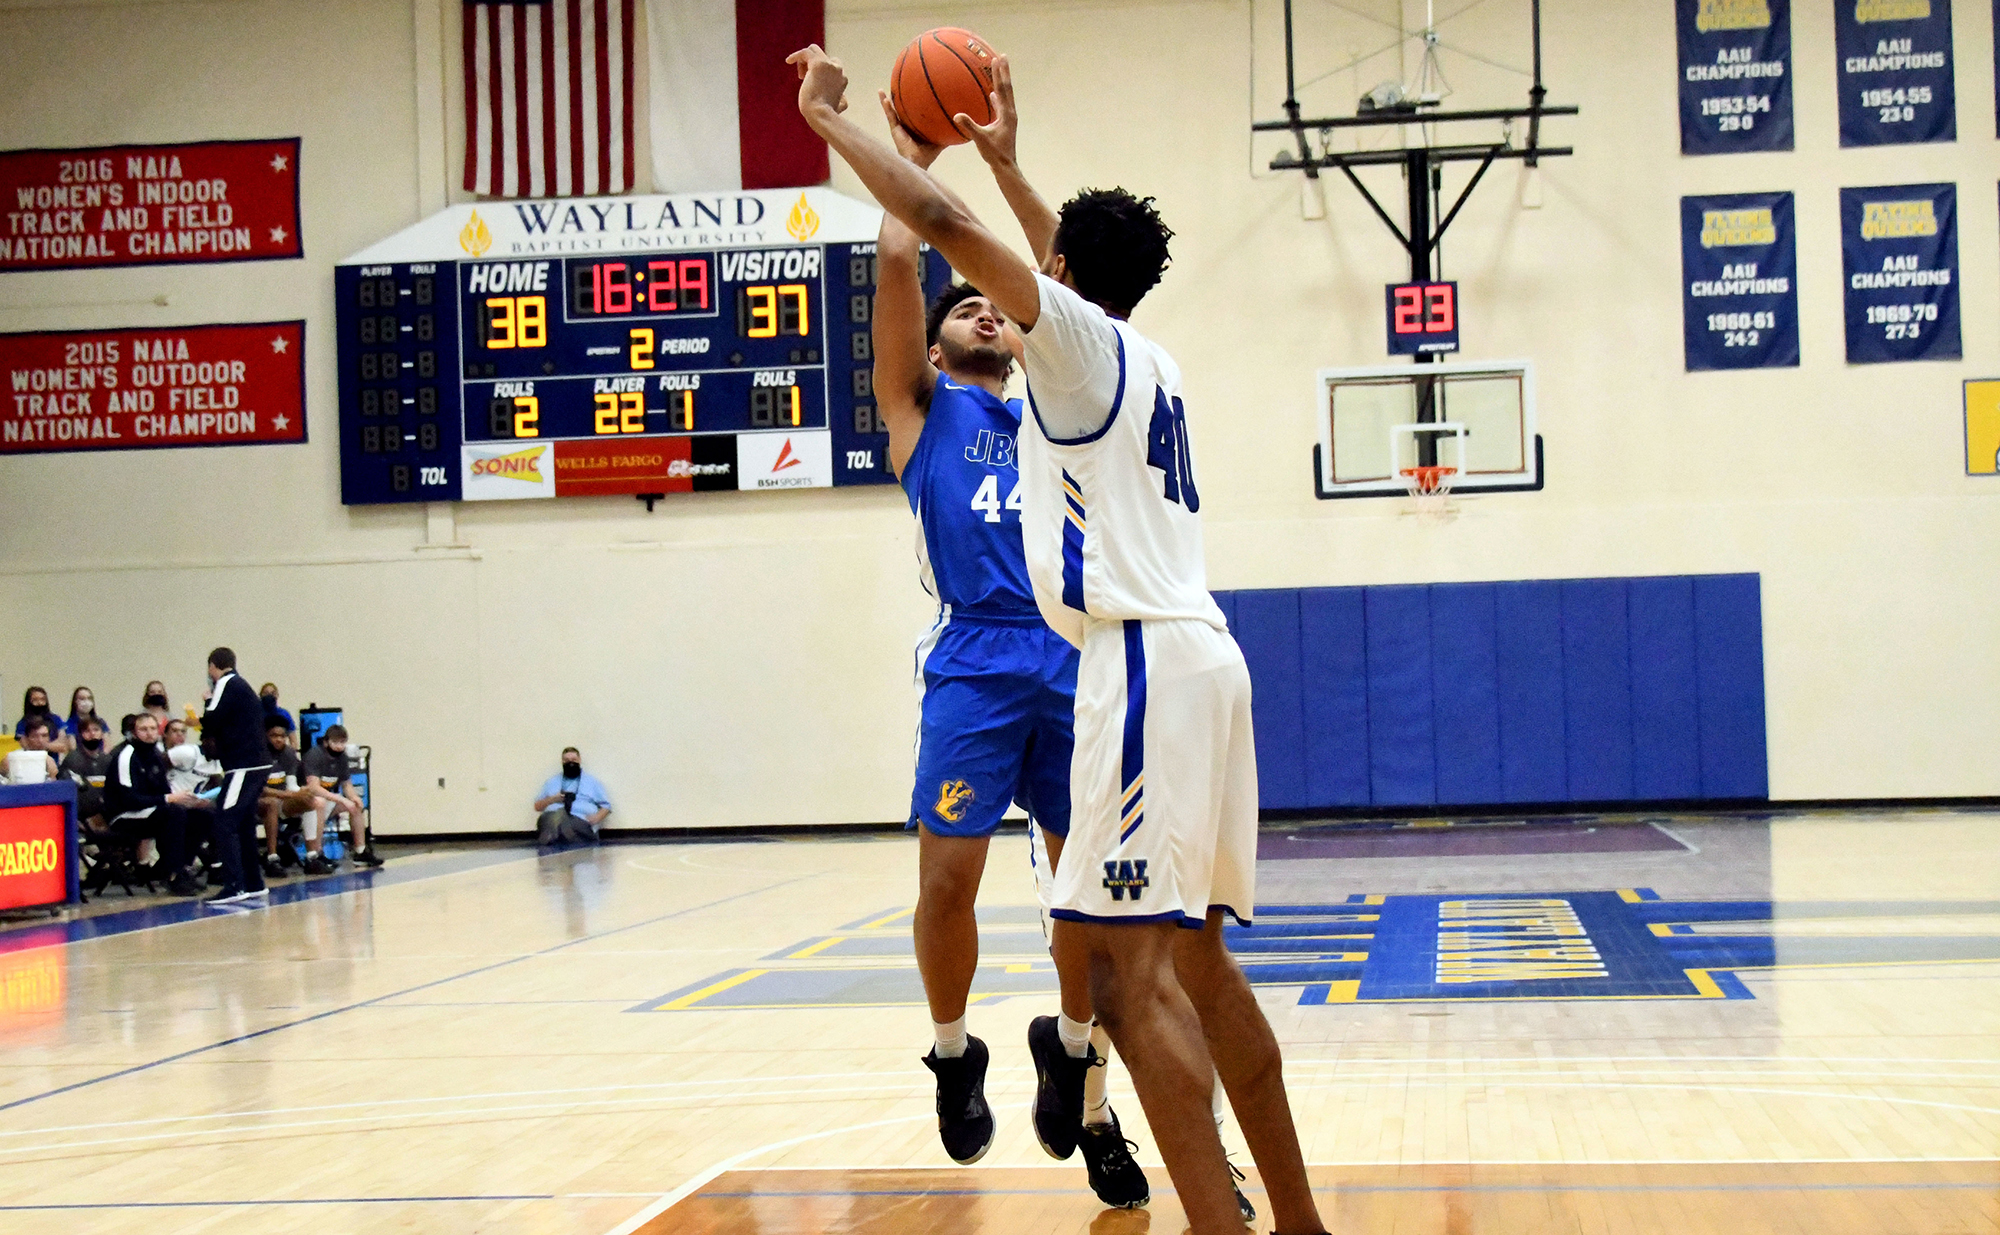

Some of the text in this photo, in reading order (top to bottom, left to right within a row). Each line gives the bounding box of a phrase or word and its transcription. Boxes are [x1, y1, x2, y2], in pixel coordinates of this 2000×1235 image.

[1717, 47, 1752, 64] AAU
[1876, 39, 1911, 55] AAU
[1686, 61, 1783, 81] CHAMPIONS
[1846, 52, 1945, 73] CHAMPIONS
[1861, 86, 1931, 108] 1954-55
[59, 155, 183, 183] 2016 NAIA
[17, 179, 227, 210] WOMEN'S INDOOR
[7, 204, 233, 235] TRACK AND FIELD
[514, 198, 764, 234] WAYLAND
[0, 228, 251, 261] NATIONAL CHAMPION
[512, 231, 766, 253] BAPTIST UNIVERSITY
[851, 243, 877, 255] PLAYE
[361, 265, 393, 277] PLAYER
[721, 250, 821, 281] VISITOR
[1721, 263, 1757, 279] AAU
[1882, 255, 1918, 271] AAU
[469, 263, 549, 293] HOME
[593, 259, 708, 314] 16:29
[1691, 277, 1788, 296] CHAMPIONS
[1852, 269, 1951, 289] CHAMPIONS
[486, 296, 546, 349] 38
[746, 284, 809, 337] 37
[1394, 285, 1454, 333] 23
[65, 339, 190, 365] 2015 NAIA
[630, 328, 655, 370] 2
[661, 337, 710, 354] PERIOD
[11, 361, 246, 391] WOMEN'S OUTDOOR
[494, 382, 534, 398] FOULS
[594, 375, 700, 394] PLAYER FOULS
[753, 371, 796, 387] FOULS
[13, 386, 239, 417] TRACK AND FIELD
[594, 392, 644, 434] 22
[684, 390, 693, 430] 1
[791, 386, 800, 426] 1
[3, 411, 256, 442] NATIONAL CHAMPION
[514, 396, 538, 437] 2
[556, 454, 663, 469] WELLS FARGO
[846, 451, 874, 470] TOL
[965, 429, 1019, 471] JB
[1147, 383, 1201, 514] 40
[420, 467, 447, 485] TOL
[472, 455, 540, 476] SONIC
[780, 477, 812, 486] SPORTS
[0, 838, 58, 876] FARGO
[1102, 859, 1149, 901] W
[1435, 900, 1609, 984] WAYLAND
